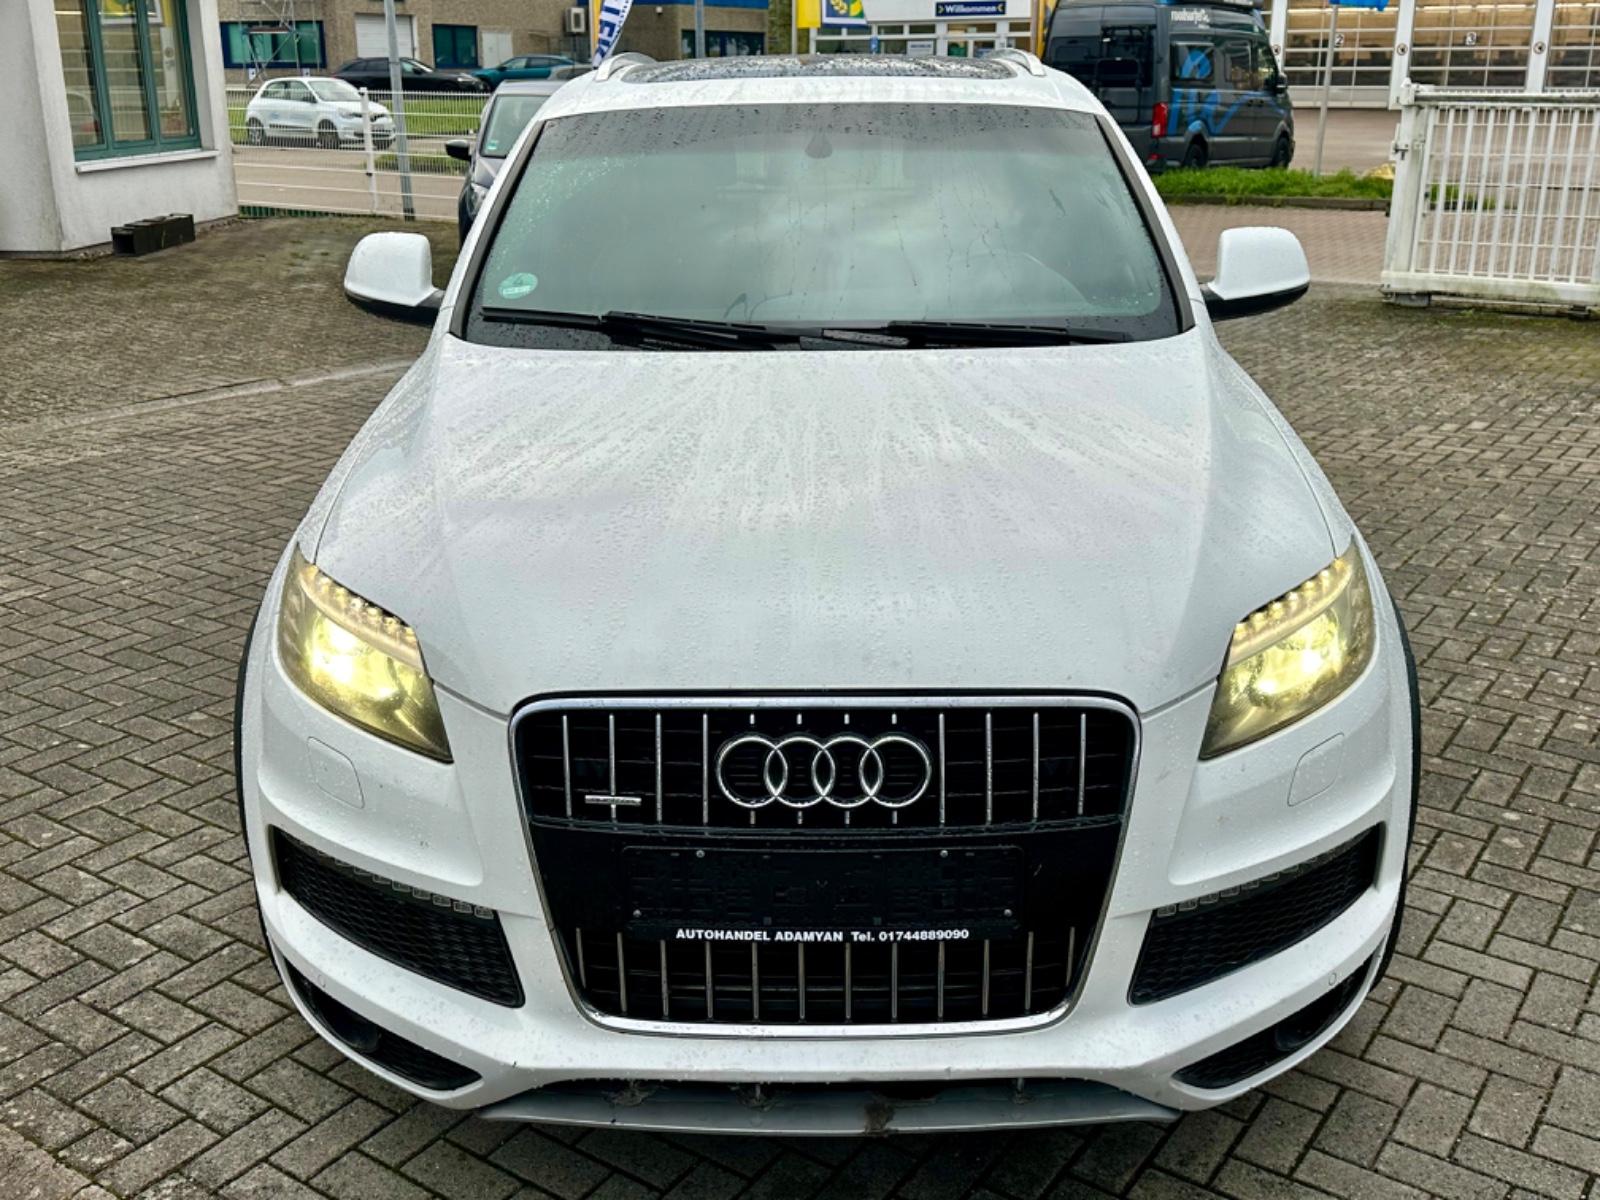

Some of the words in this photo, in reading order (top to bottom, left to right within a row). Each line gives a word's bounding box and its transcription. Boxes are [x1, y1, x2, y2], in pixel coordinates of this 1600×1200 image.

[676, 928, 771, 940] AUTOHANDEL
[774, 931, 843, 942] ADAMYAN
[851, 931, 875, 941] Tel.
[878, 929, 969, 941] 01744889090
